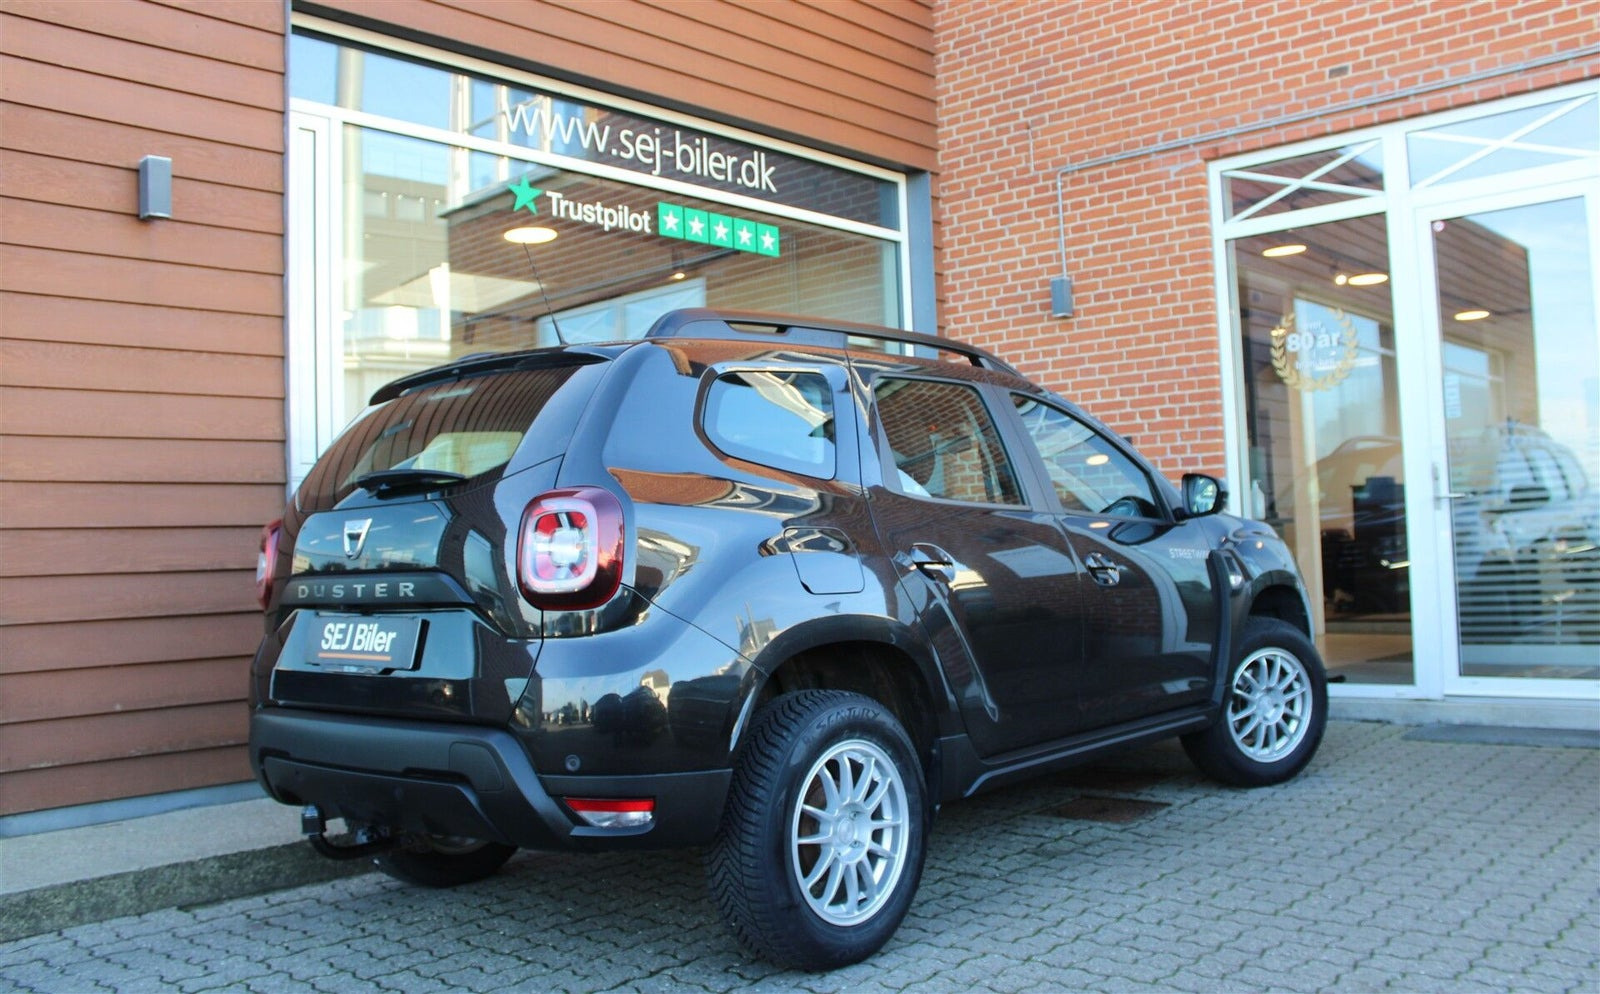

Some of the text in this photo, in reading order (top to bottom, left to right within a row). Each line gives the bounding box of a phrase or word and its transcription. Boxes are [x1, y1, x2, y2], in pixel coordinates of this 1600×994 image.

[501, 101, 778, 193] www.sej-biler.dk
[546, 190, 651, 233] Trustpilot
[1286, 326, 1341, 352] 80 år
[297, 581, 416, 599] DUSTER
[321, 622, 397, 652] SEJ Biler
